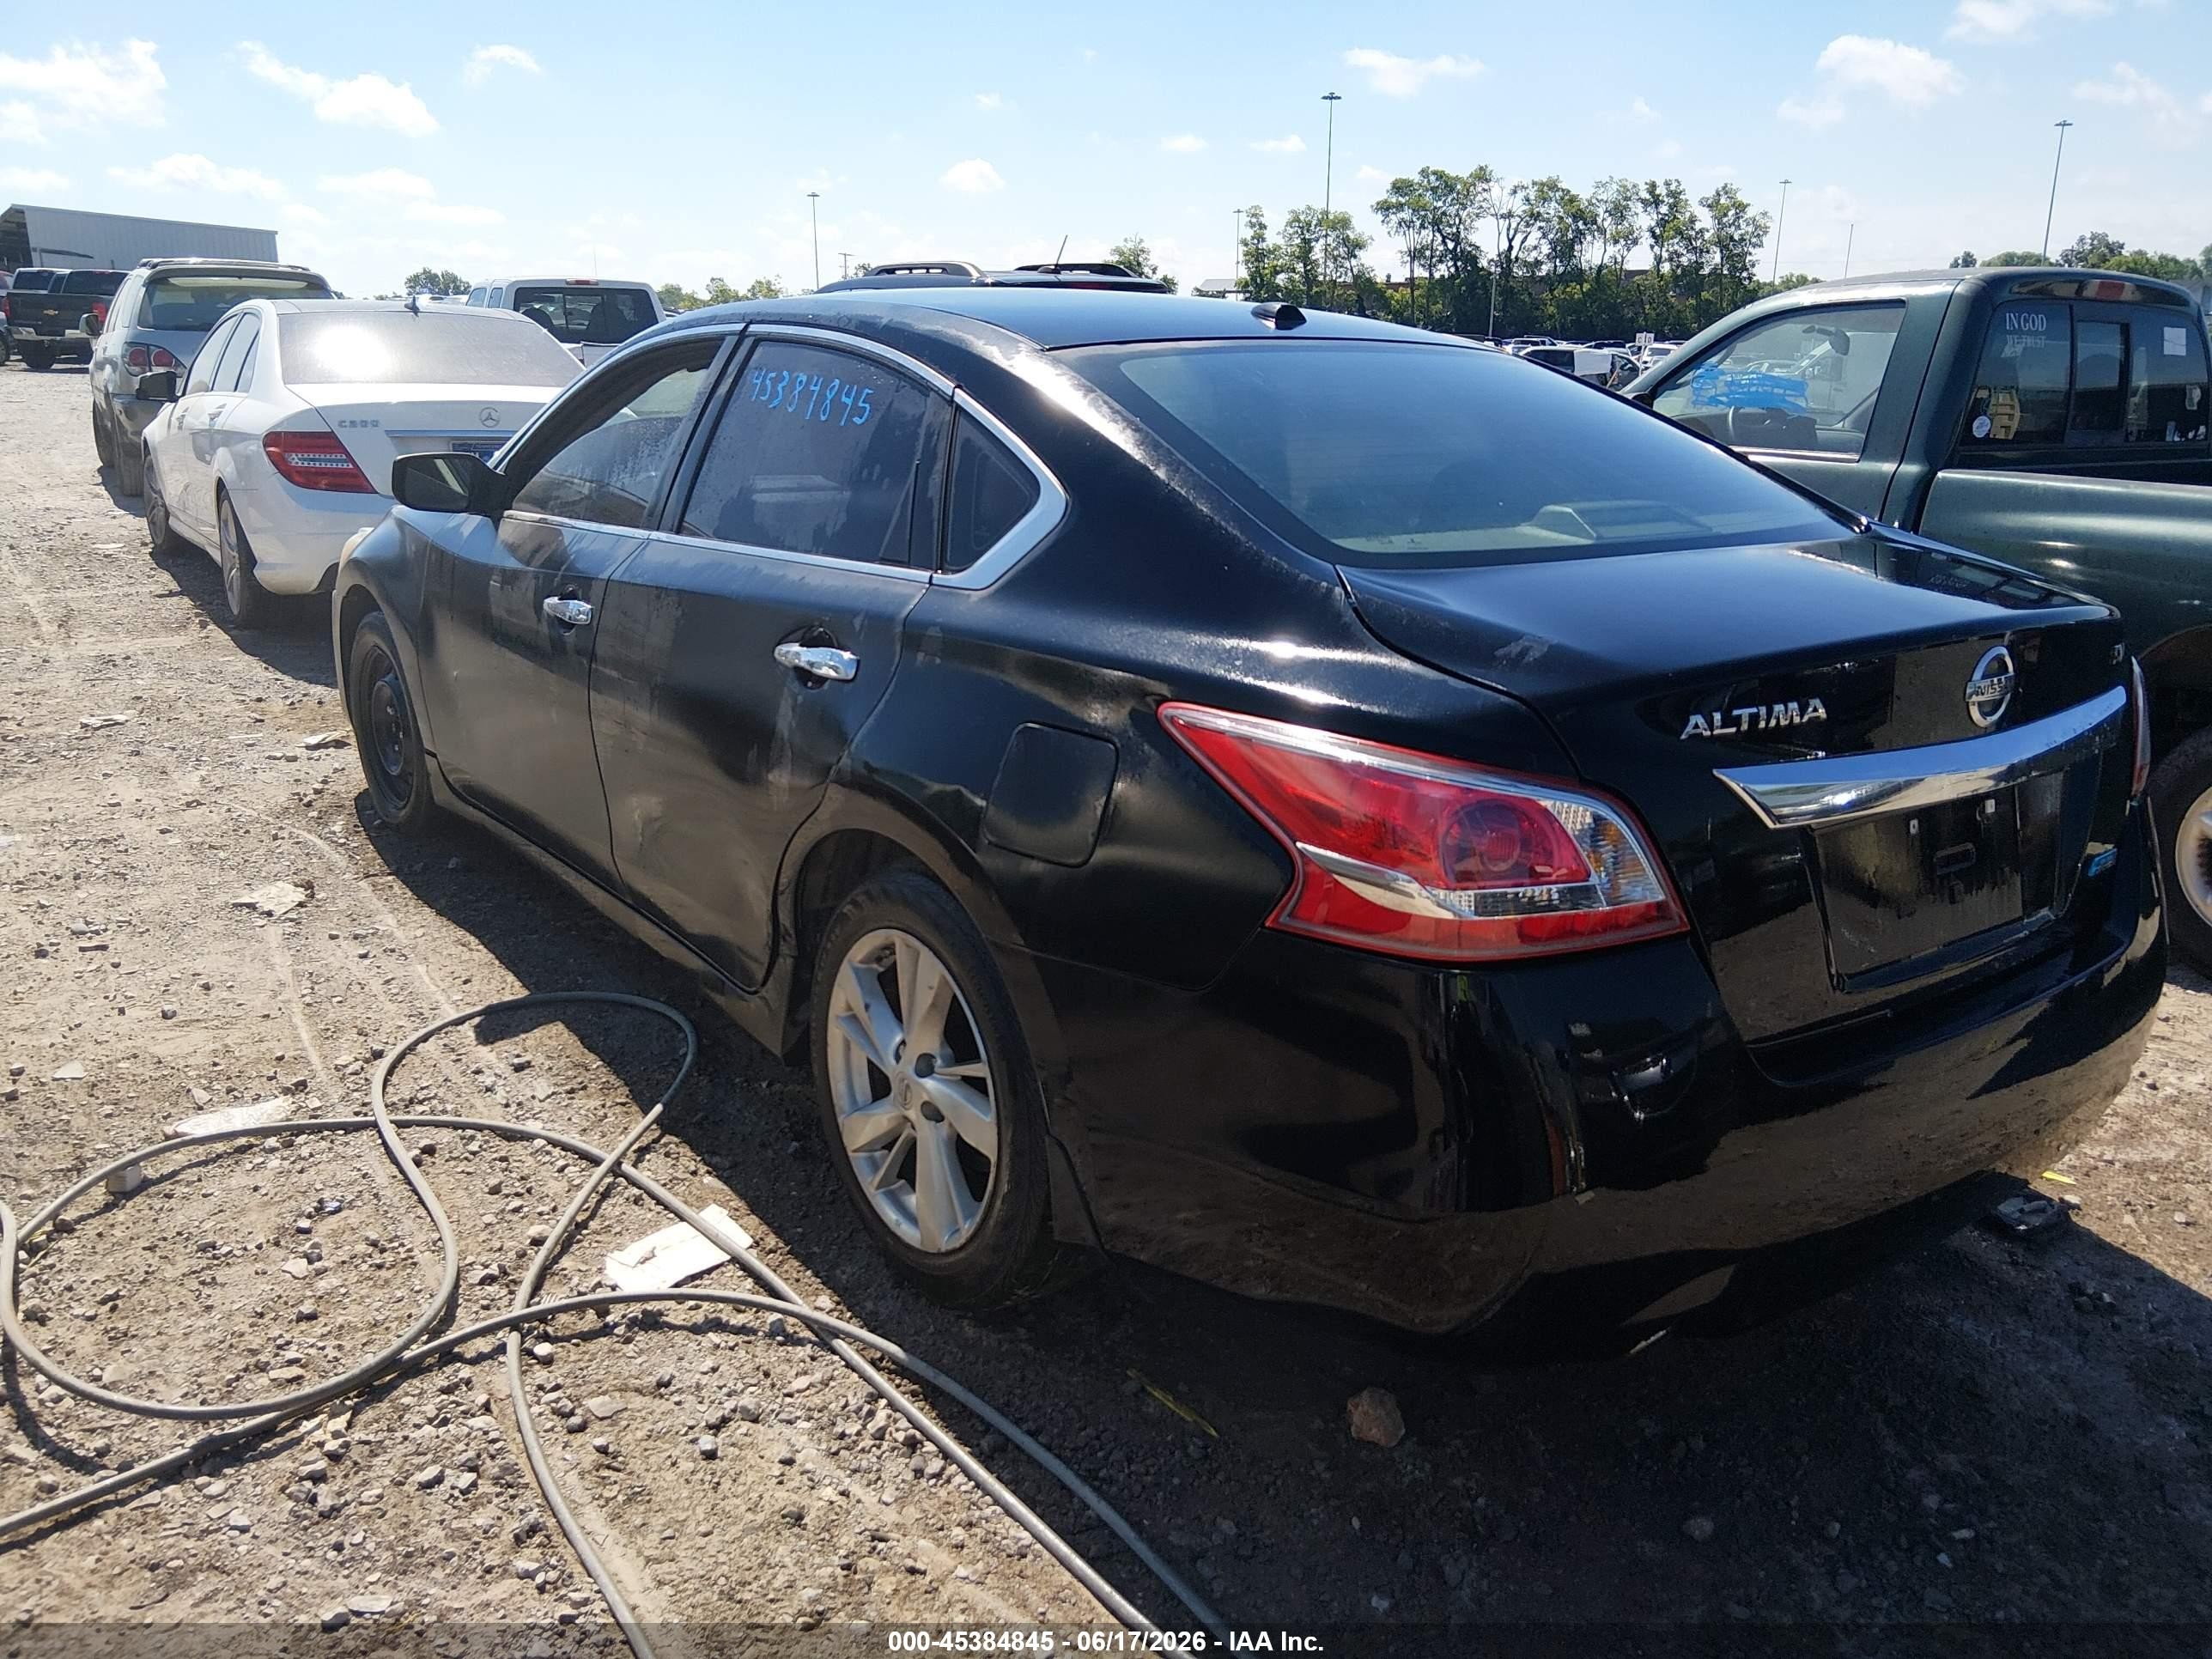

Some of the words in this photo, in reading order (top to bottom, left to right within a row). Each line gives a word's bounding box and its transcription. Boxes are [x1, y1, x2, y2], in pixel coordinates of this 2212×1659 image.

[2006, 313, 2019, 331] IN
[2021, 313, 2047, 331] GOD
[2006, 335, 2021, 347] WE
[751, 368, 874, 426] 45384845
[1680, 697, 1827, 739] ALTIMA
